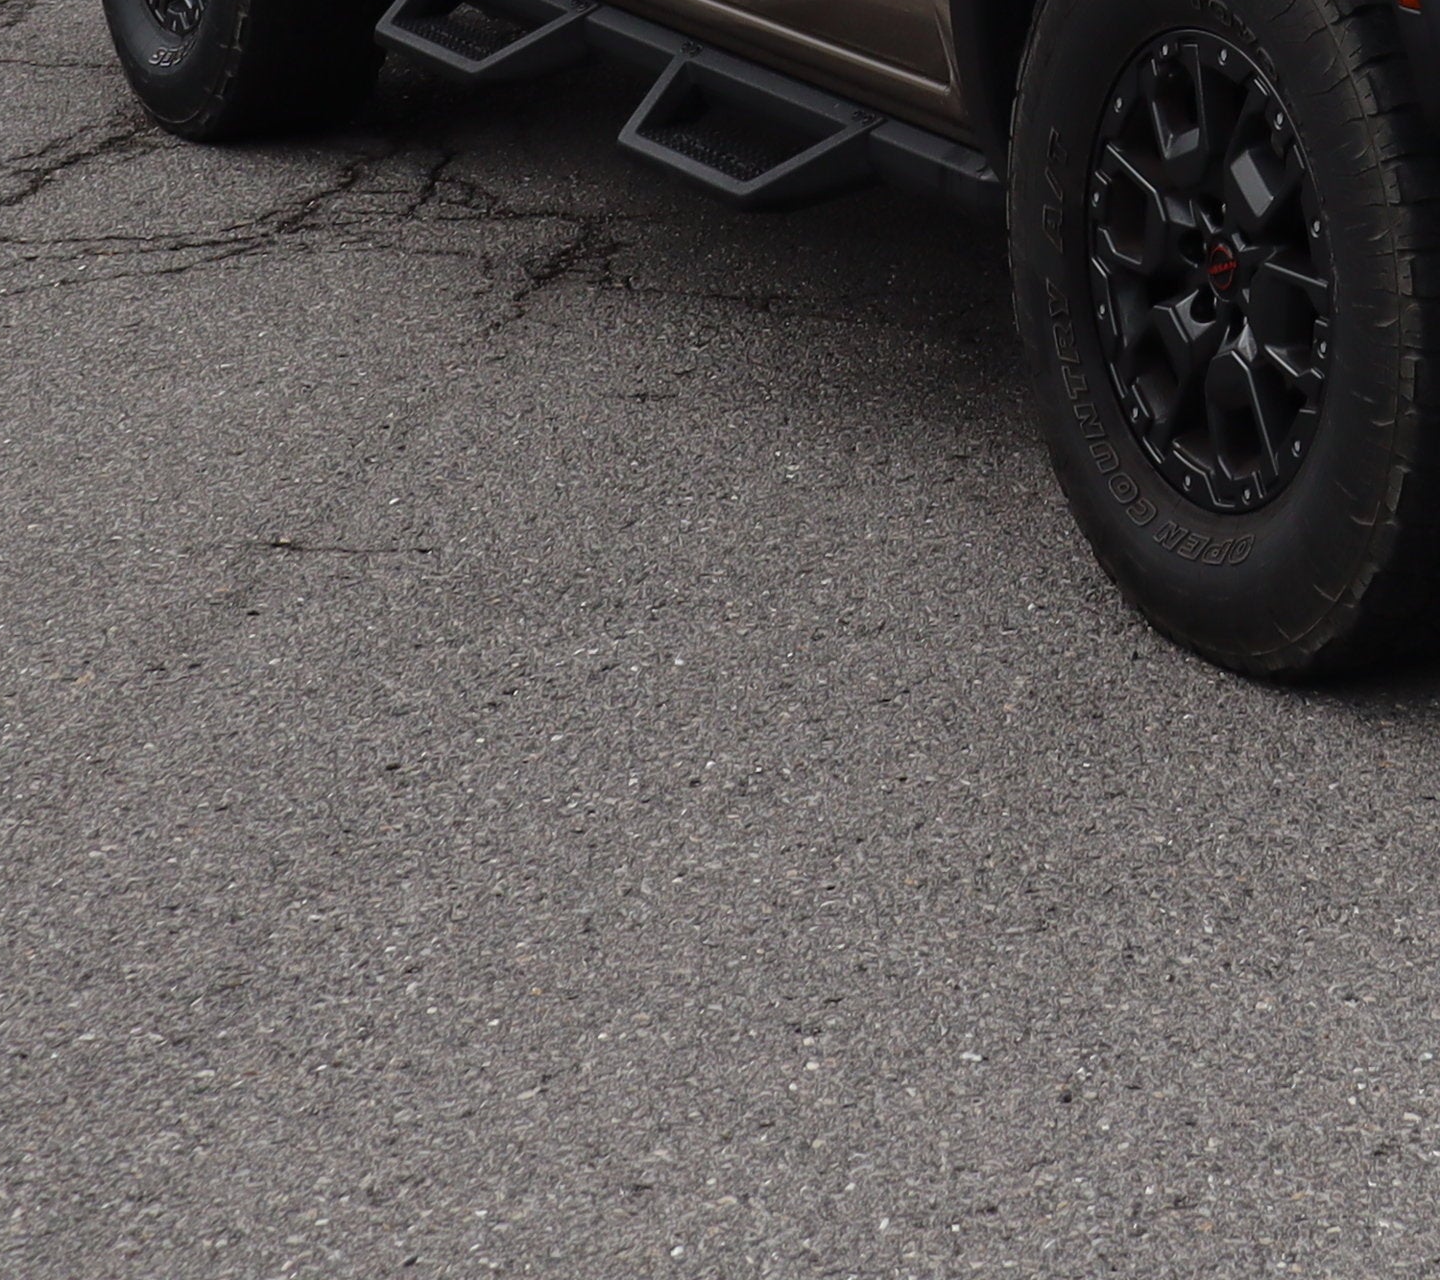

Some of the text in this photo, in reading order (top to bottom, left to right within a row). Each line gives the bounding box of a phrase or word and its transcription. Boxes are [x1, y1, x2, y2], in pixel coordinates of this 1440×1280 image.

[1041, 125, 1255, 566] OPEN COUNTRY A/T
